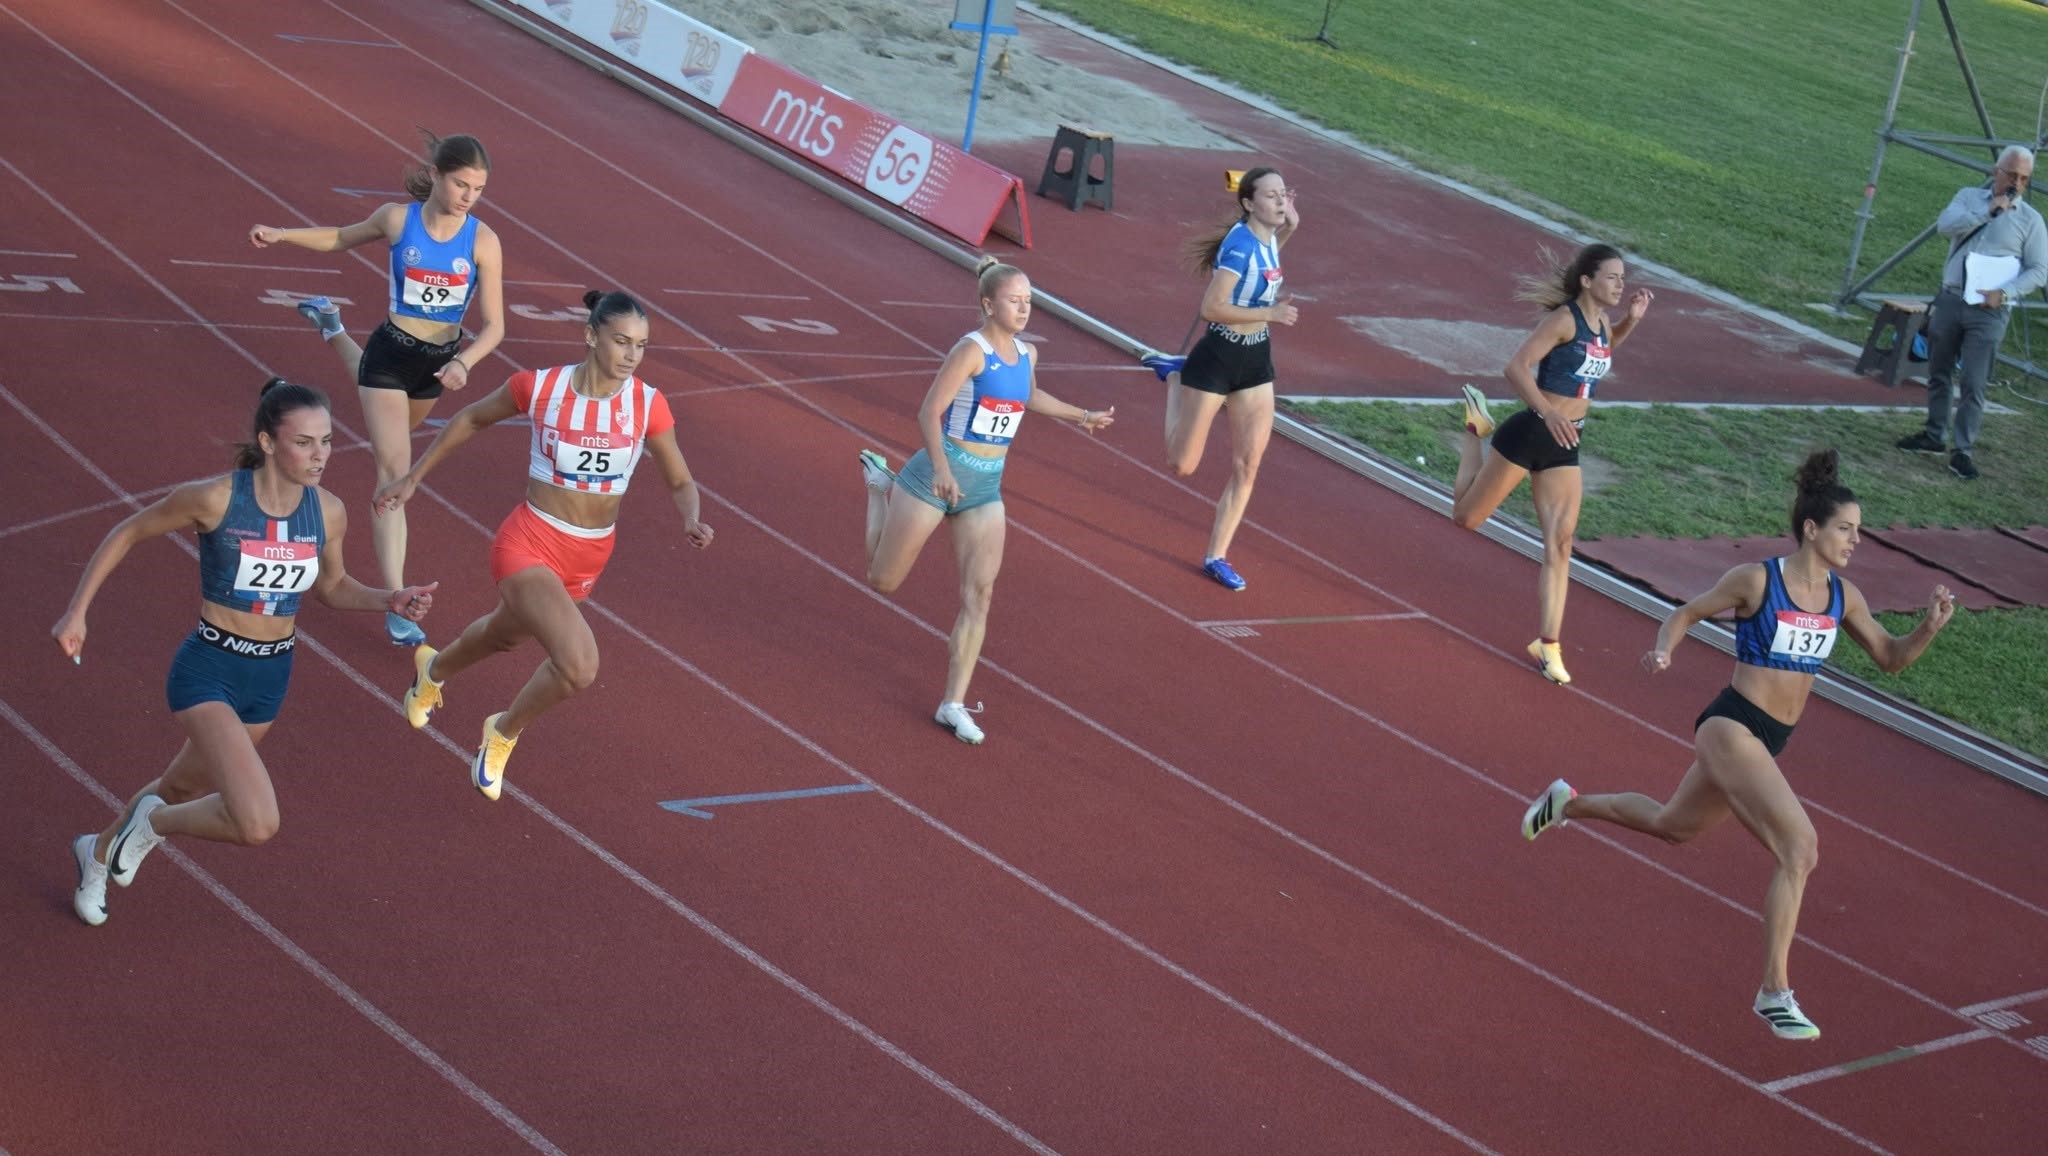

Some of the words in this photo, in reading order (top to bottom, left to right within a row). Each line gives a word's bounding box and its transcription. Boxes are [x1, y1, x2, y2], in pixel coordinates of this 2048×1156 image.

[760, 88, 844, 158] mts
[875, 137, 920, 186] 5G
[423, 274, 450, 286] mts
[421, 286, 450, 303] 69
[739, 315, 840, 336] 2
[1214, 323, 1240, 343] PRO
[1241, 328, 1267, 346] NIKE
[1584, 360, 1606, 377] 230
[994, 403, 1013, 413] mts
[990, 416, 1010, 434] 19
[581, 435, 610, 448] mts
[576, 450, 611, 473] 25
[959, 452, 994, 471] NIKE
[264, 545, 295, 559] mts
[248, 562, 307, 590] 227
[1795, 616, 1820, 628] mts
[222, 635, 274, 656] NIKE
[1787, 630, 1826, 654] 137
